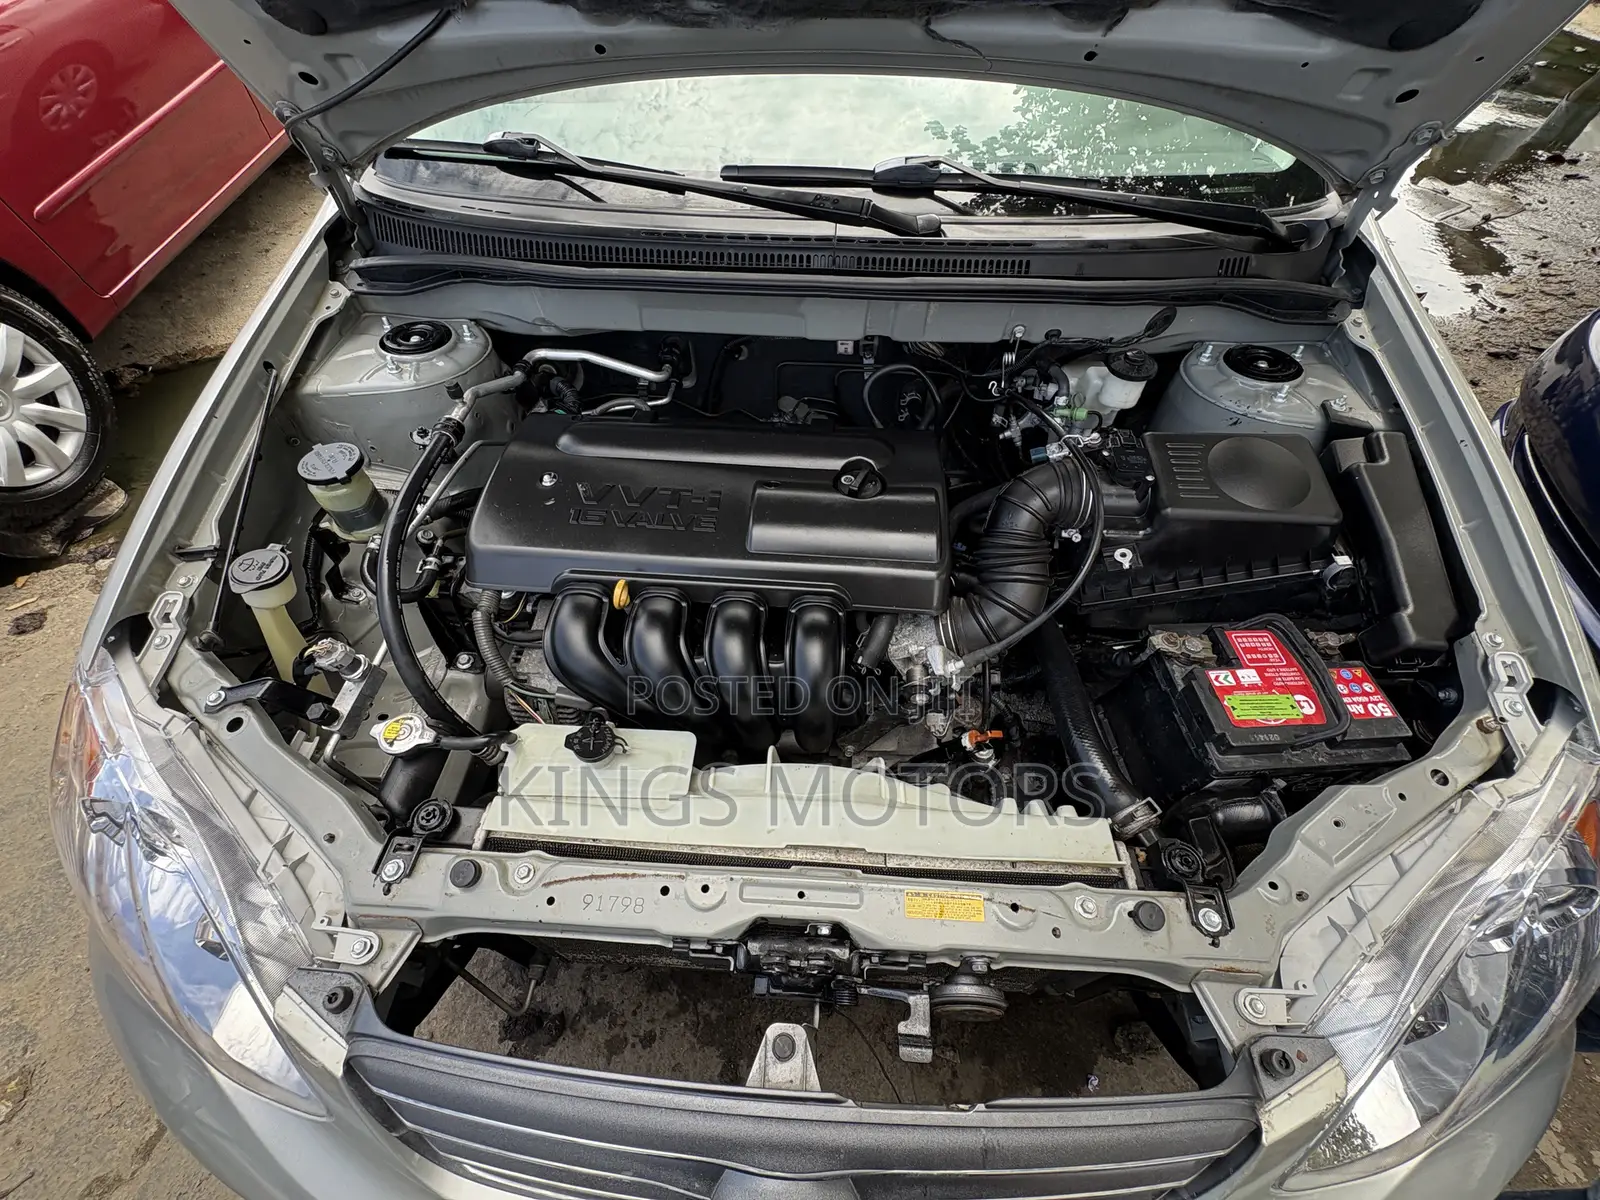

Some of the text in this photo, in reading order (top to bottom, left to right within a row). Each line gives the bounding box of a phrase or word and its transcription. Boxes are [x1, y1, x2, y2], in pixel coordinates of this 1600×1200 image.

[1347, 702, 1393, 717] 50 Ah
[582, 893, 645, 914] 91798
